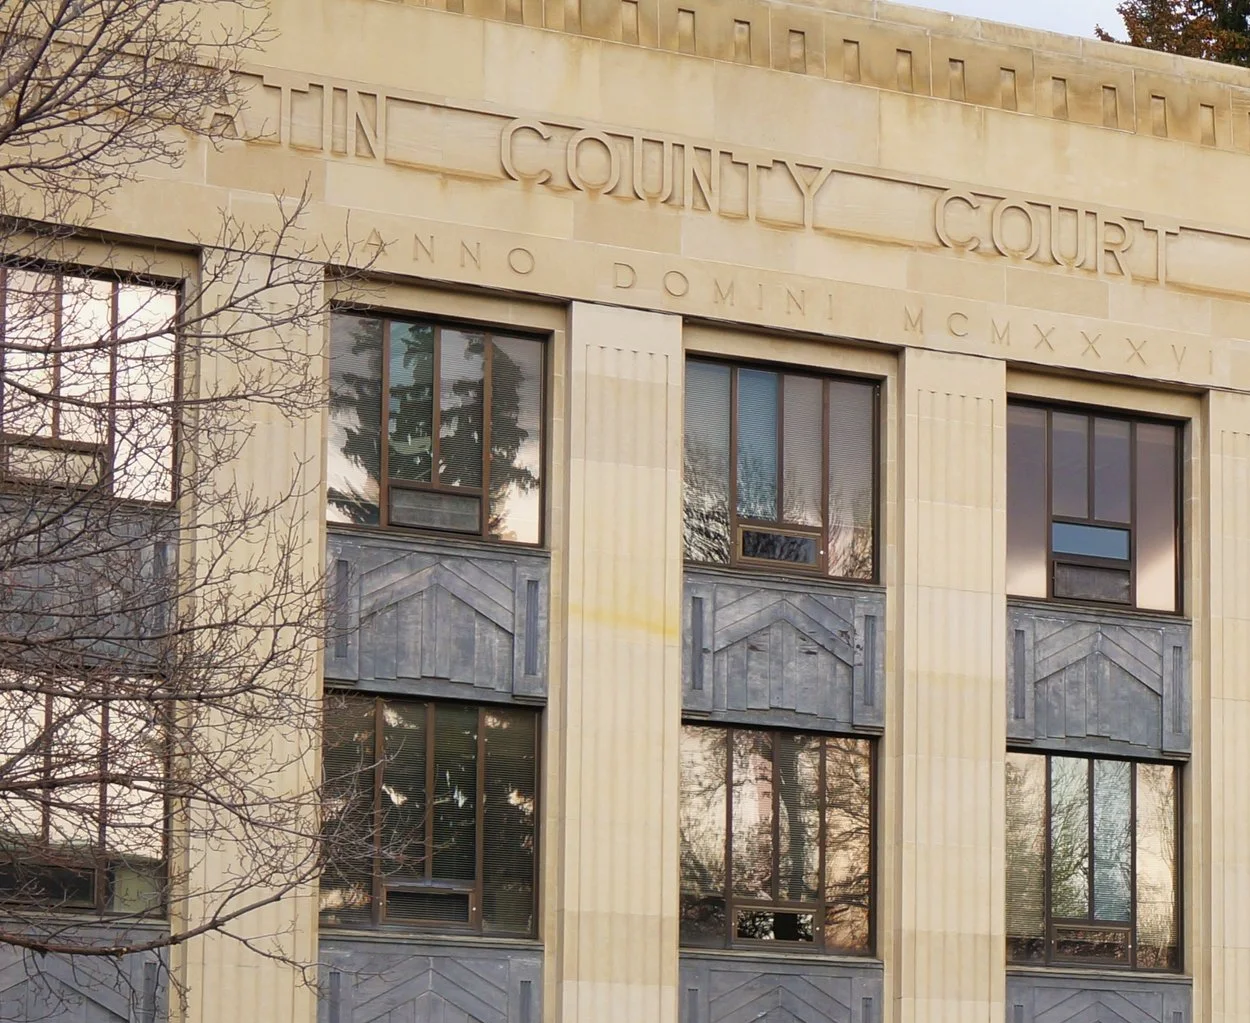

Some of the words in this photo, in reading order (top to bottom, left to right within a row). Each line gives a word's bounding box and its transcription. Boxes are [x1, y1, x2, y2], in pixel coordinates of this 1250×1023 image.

[500, 116, 832, 228] COUNTY
[934, 188, 1180, 284] COURT
[361, 227, 536, 275] ANNO
[613, 261, 834, 320] DOMINI
[903, 304, 1214, 375] MCMXXXVI
